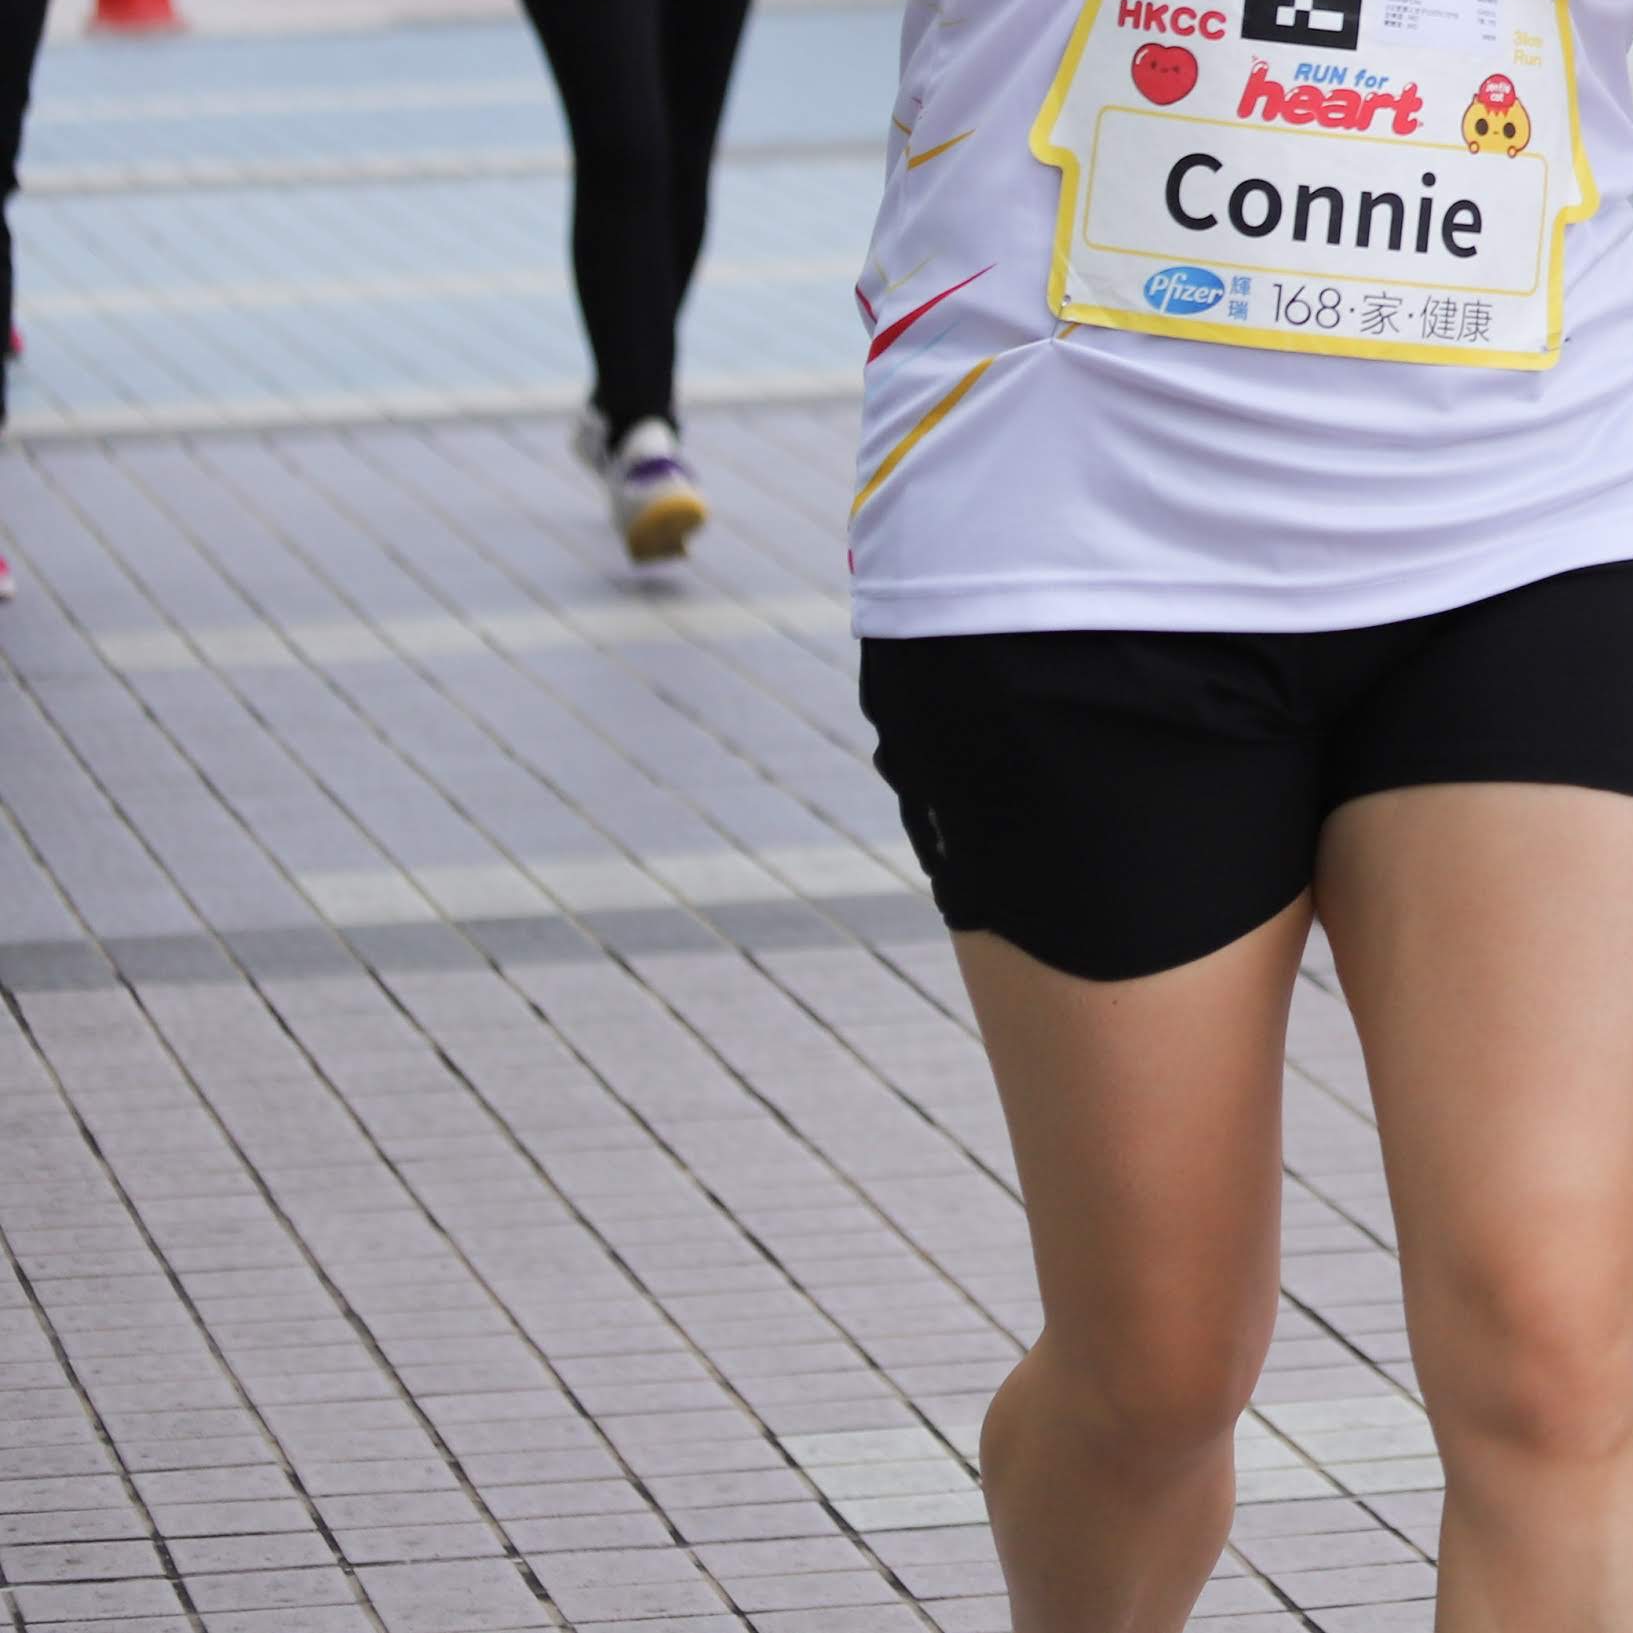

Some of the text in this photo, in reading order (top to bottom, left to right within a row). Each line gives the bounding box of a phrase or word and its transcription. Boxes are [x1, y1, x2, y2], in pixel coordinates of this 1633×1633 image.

[1237, 61, 1422, 135] heart
[1294, 62, 1390, 90] RUN for
[1165, 152, 1482, 258] Connie
[1148, 272, 1224, 313] Pfizer
